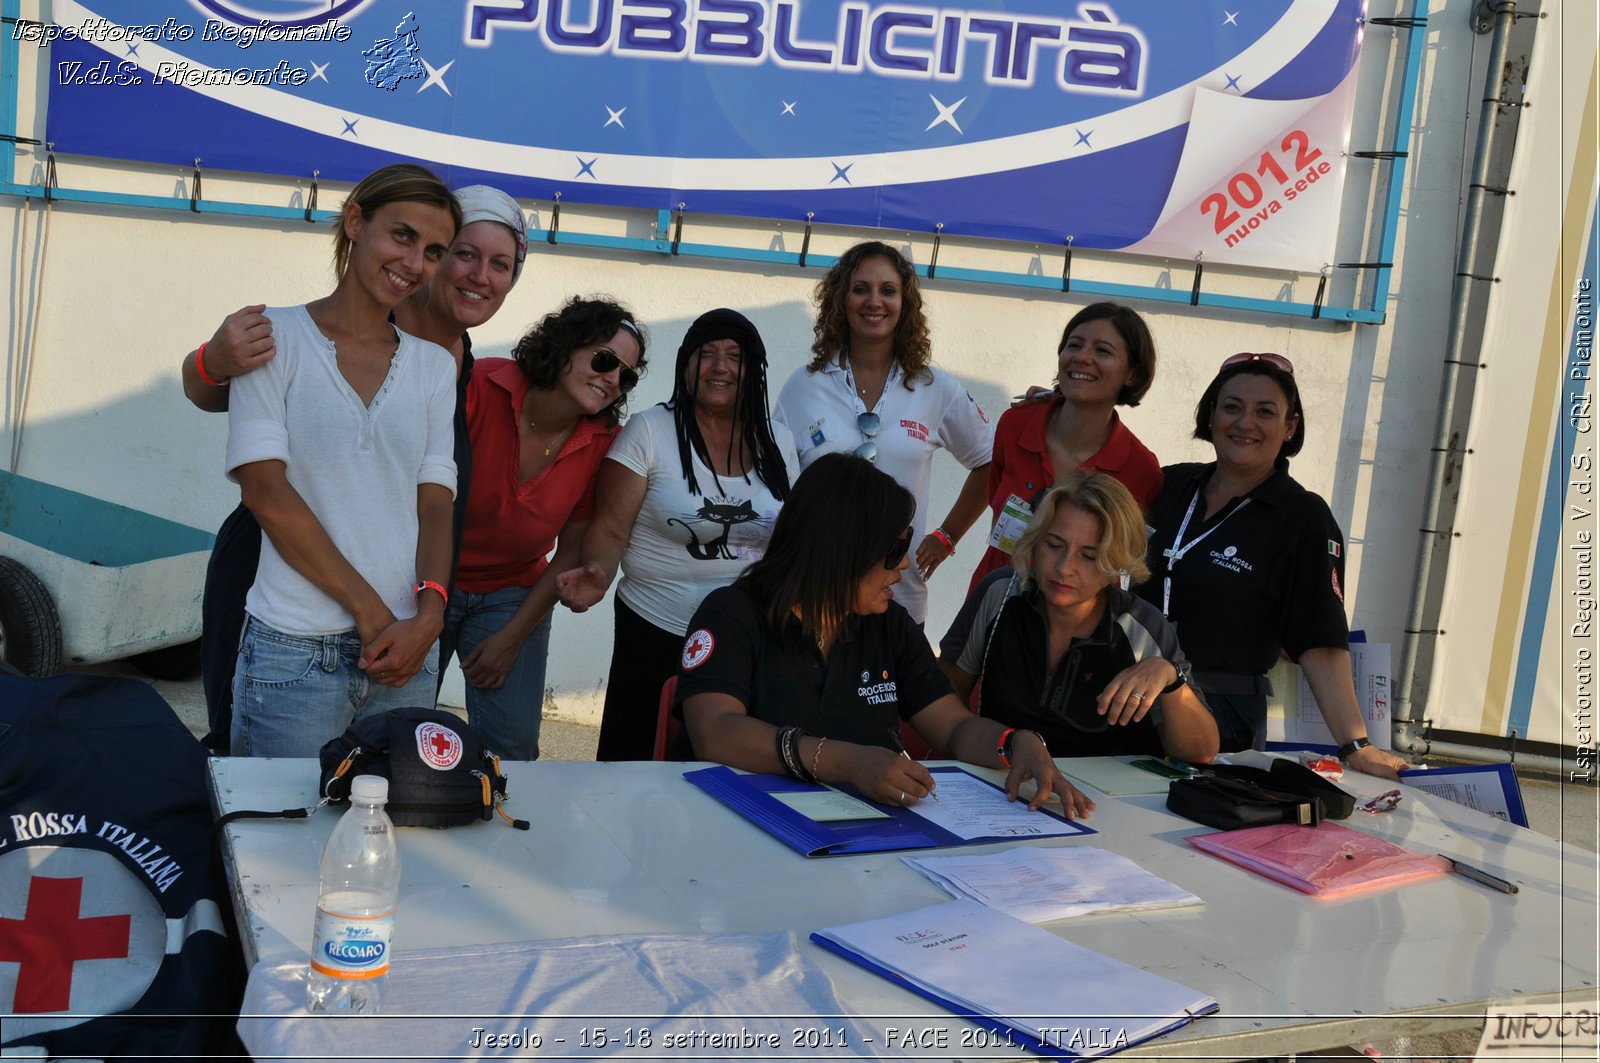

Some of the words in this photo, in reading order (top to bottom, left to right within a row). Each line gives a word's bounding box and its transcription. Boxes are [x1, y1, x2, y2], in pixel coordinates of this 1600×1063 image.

[1200, 130, 1323, 235] 2012
[1224, 200, 1282, 248] nuova
[1284, 161, 1331, 201] sede
[900, 419, 918, 430] CROCE
[1212, 558, 1240, 573] ITALIANA
[1232, 556, 1252, 571] ROSSA
[10, 811, 88, 842] ROSSA
[95, 820, 184, 894] ITALIANA
[328, 942, 383, 958] RECOARO
